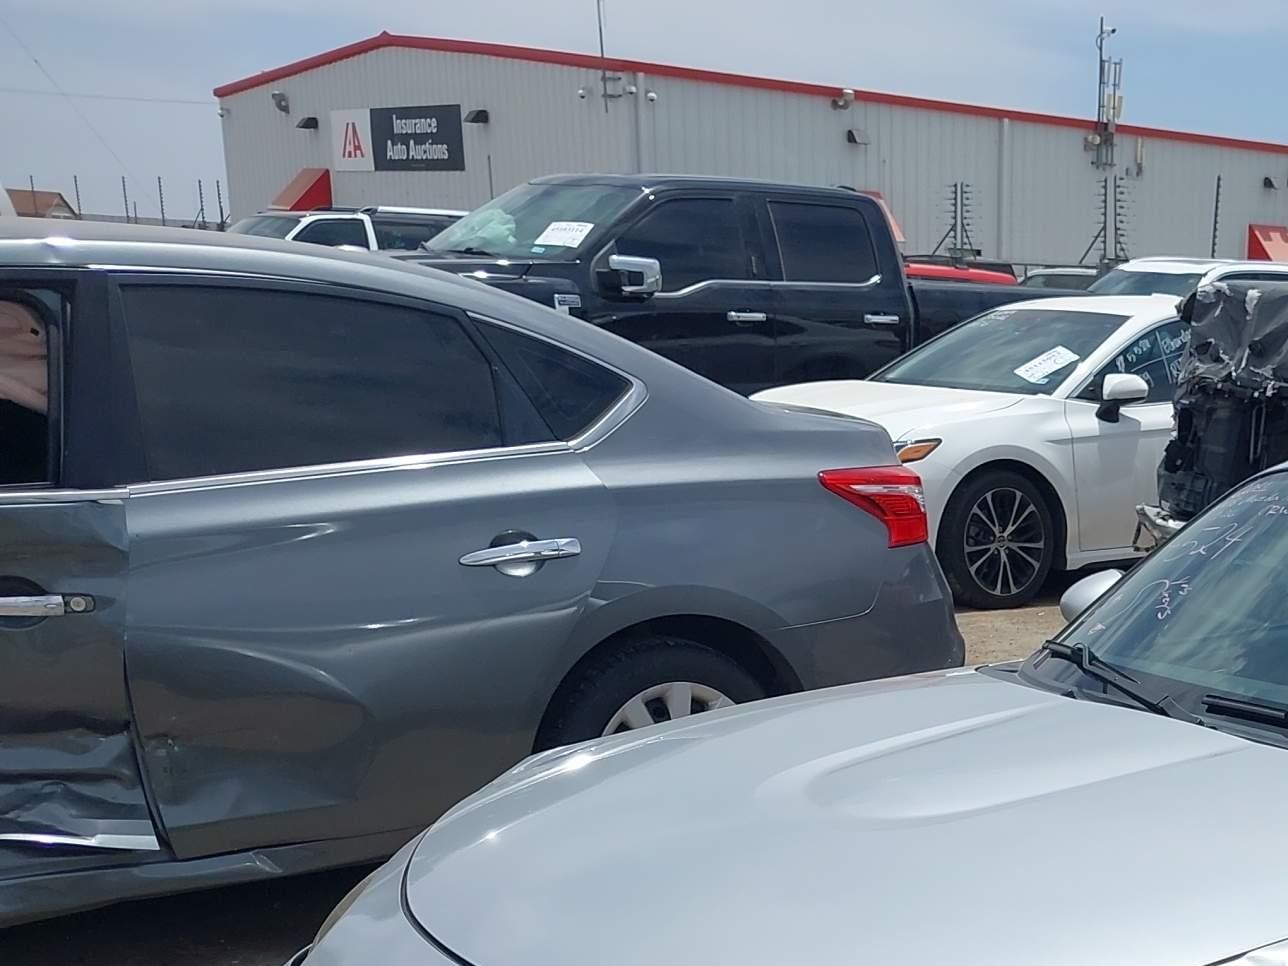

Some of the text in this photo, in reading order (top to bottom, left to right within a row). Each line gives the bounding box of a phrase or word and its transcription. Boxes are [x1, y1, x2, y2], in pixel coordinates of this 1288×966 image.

[392, 114, 438, 134] Insurance
[386, 139, 449, 160] Auto Auctions
